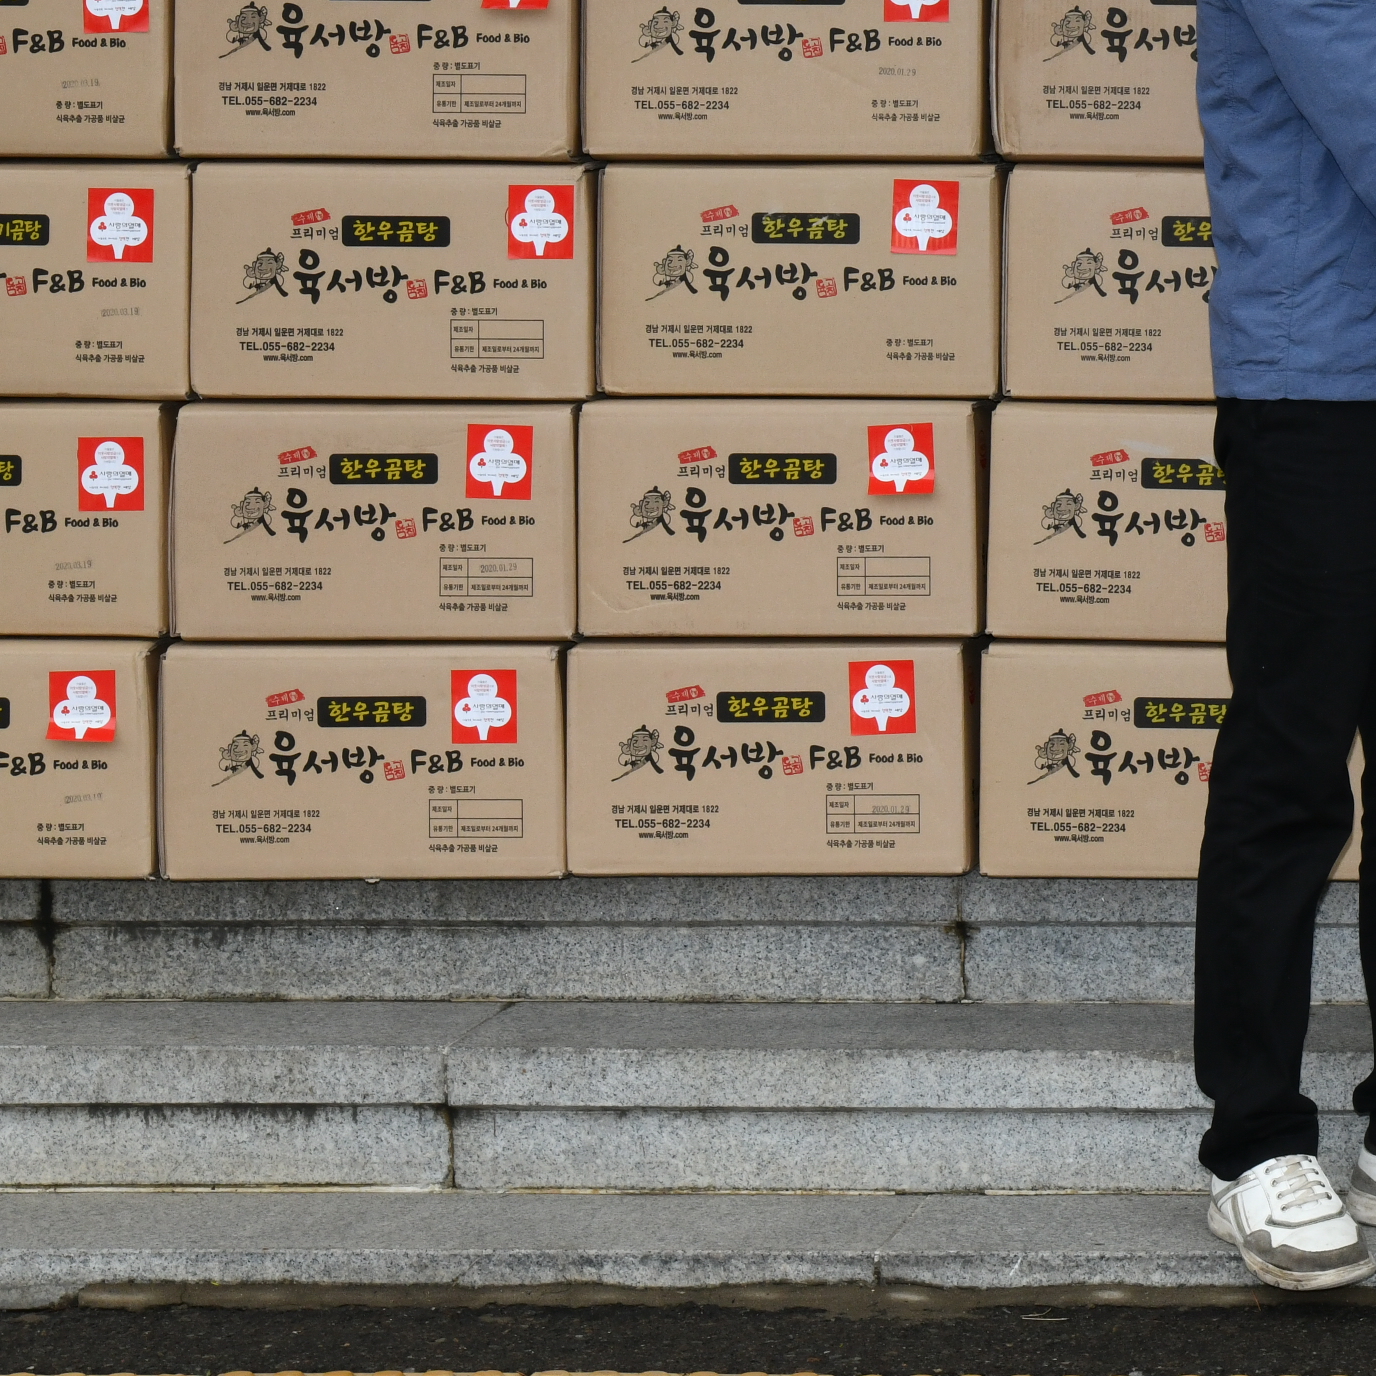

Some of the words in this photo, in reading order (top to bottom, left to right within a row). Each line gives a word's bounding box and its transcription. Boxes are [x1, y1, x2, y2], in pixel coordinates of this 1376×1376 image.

[276, 2, 392, 59] 육서방
[417, 23, 469, 49] F&B
[476, 33, 501, 44] Food
[504, 33, 512, 43] &
[513, 33, 530, 44] Bio
[688, 7, 803, 63] 육서방
[829, 28, 881, 53] F&B
[454, 62, 481, 71] 별도표기
[218, 82, 232, 92] 경남
[234, 82, 255, 92] 거제시
[257, 82, 278, 92] 일운면
[279, 82, 307, 92] 거제대로
[309, 83, 327, 91] 1822
[222, 95, 318, 107] TEL.055-682-2234
[245, 108, 296, 117] www.육서방.com
[293, 249, 408, 305] 육서방
[740, 457, 825, 480] 한우곰탕
[668, 725, 783, 781] 육서방
[810, 745, 862, 770] F&B
